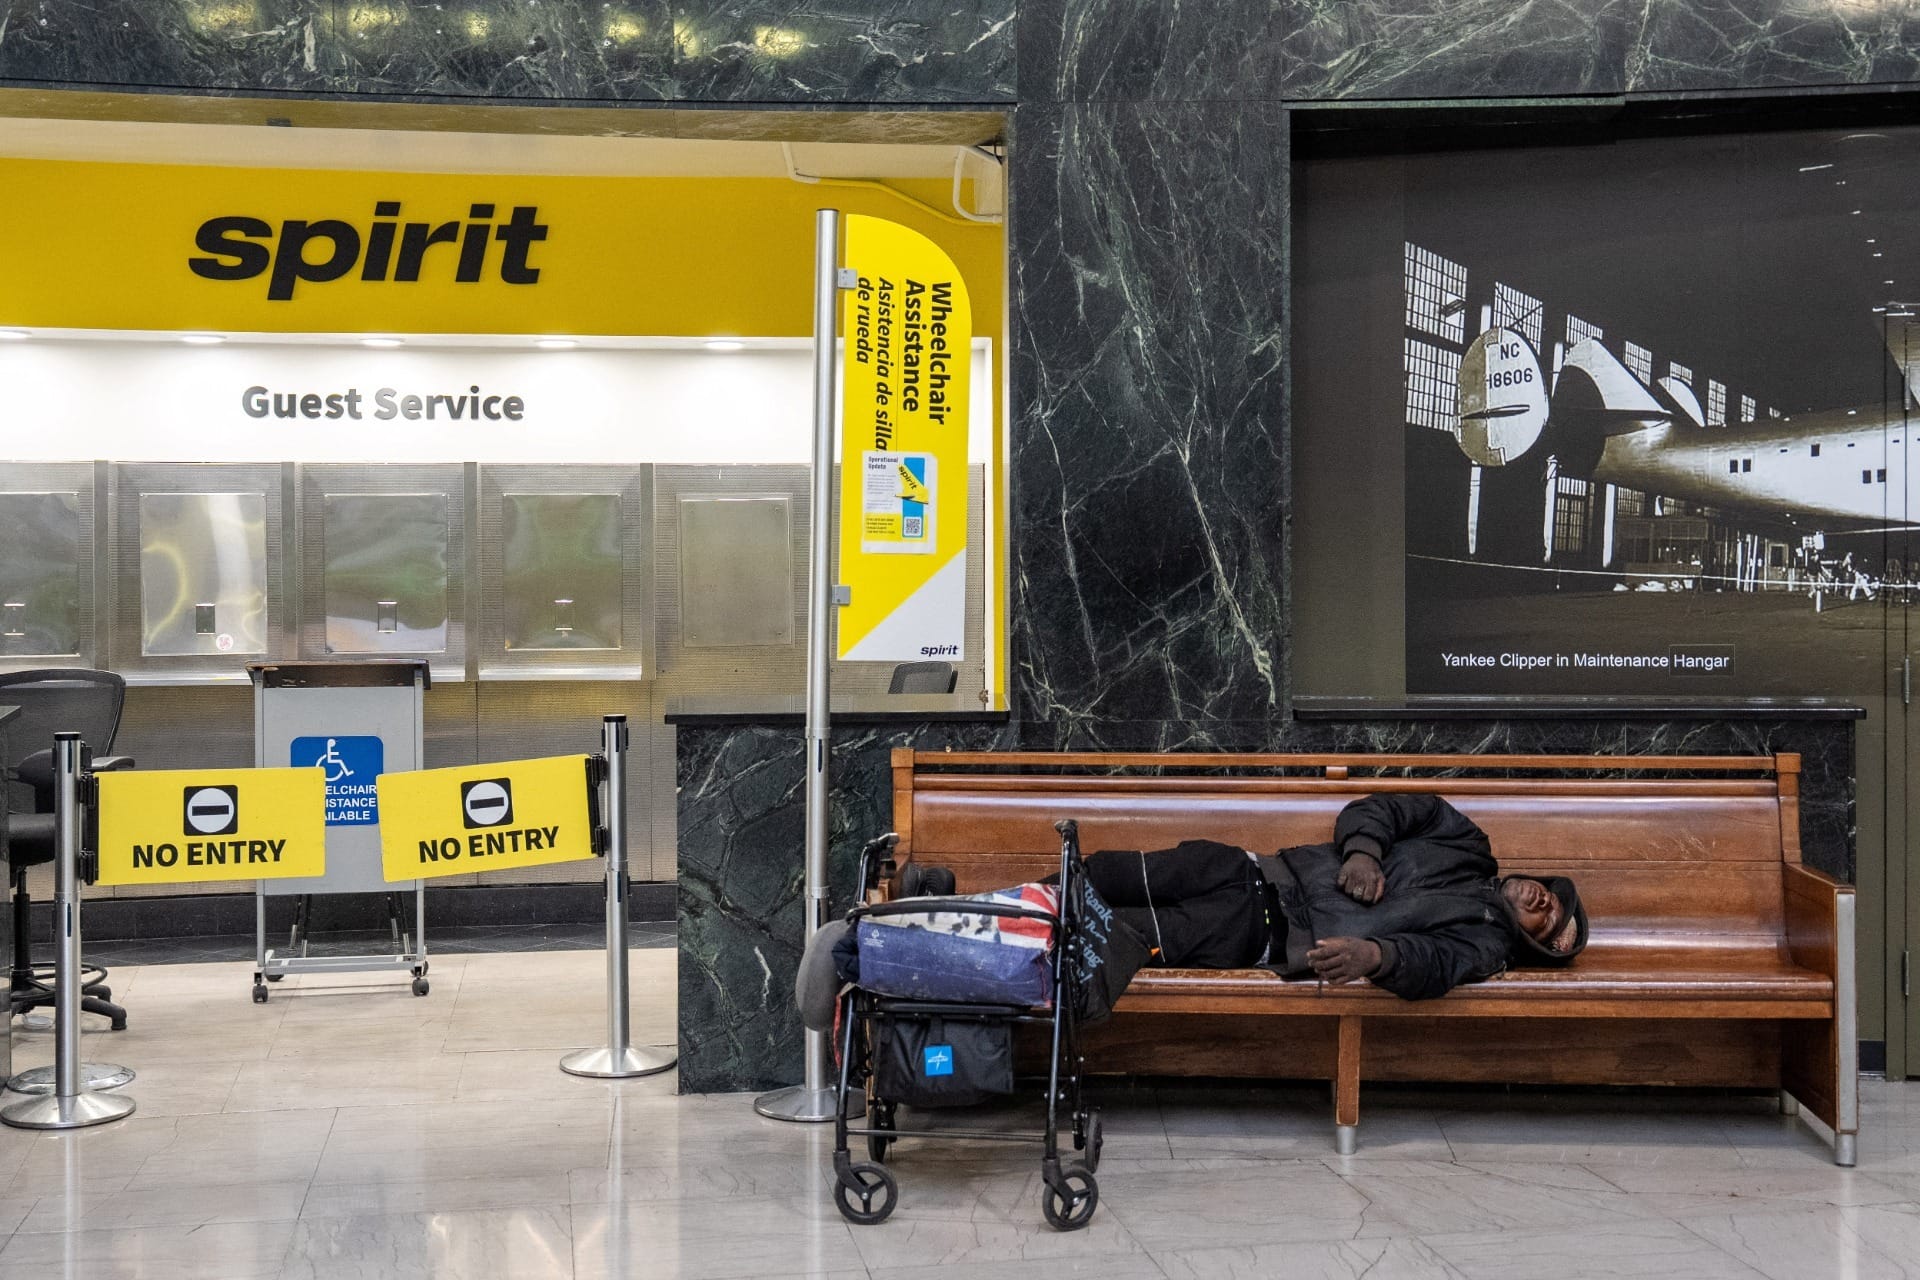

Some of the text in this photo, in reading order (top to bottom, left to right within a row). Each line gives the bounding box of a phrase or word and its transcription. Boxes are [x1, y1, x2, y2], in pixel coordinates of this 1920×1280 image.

[188, 201, 549, 301] spirit
[856, 277, 874, 364] de rueda
[902, 279, 926, 412] Assistance
[929, 282, 953, 425] Wheelchair
[1500, 342, 1520, 360] NC
[875, 276, 895, 451] Asistencia de silla
[1489, 367, 1533, 389] 18606
[242, 385, 525, 420] Guest Service
[898, 465, 917, 490] spirit
[920, 644, 960, 657] spirit
[1441, 653, 1730, 671] Yankee Clipper in Maintenance Hangar
[325, 785, 377, 795] ELCHAIR
[325, 798, 376, 808] ISTANCE
[325, 811, 371, 821] ILABLE
[133, 839, 287, 868] NO ENTRY
[419, 826, 559, 863] NO ENTRY
